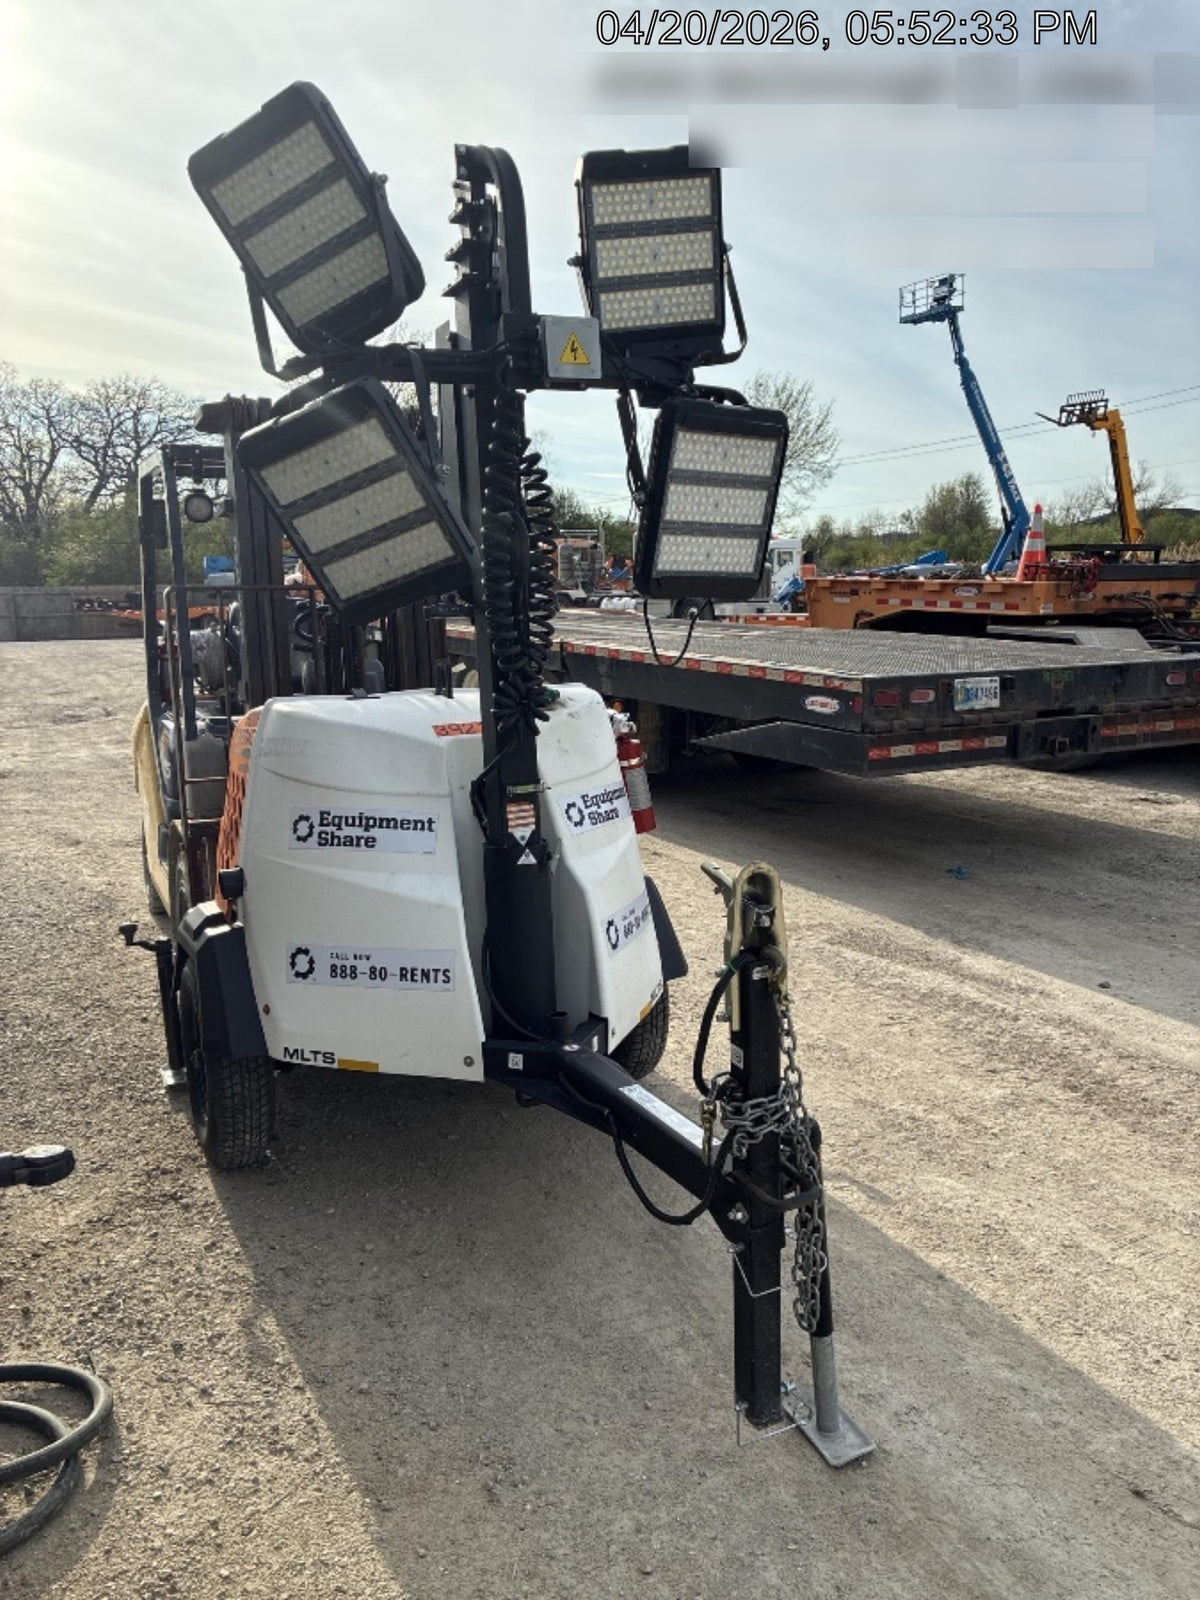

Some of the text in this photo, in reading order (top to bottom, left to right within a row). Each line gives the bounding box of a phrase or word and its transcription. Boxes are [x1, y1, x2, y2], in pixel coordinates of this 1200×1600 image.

[434, 721, 482, 737] 392
[318, 810, 437, 833] Equipment
[317, 830, 377, 849] Share
[329, 963, 452, 984] 888-80-RENTS
[283, 1046, 336, 1065] MLTS
